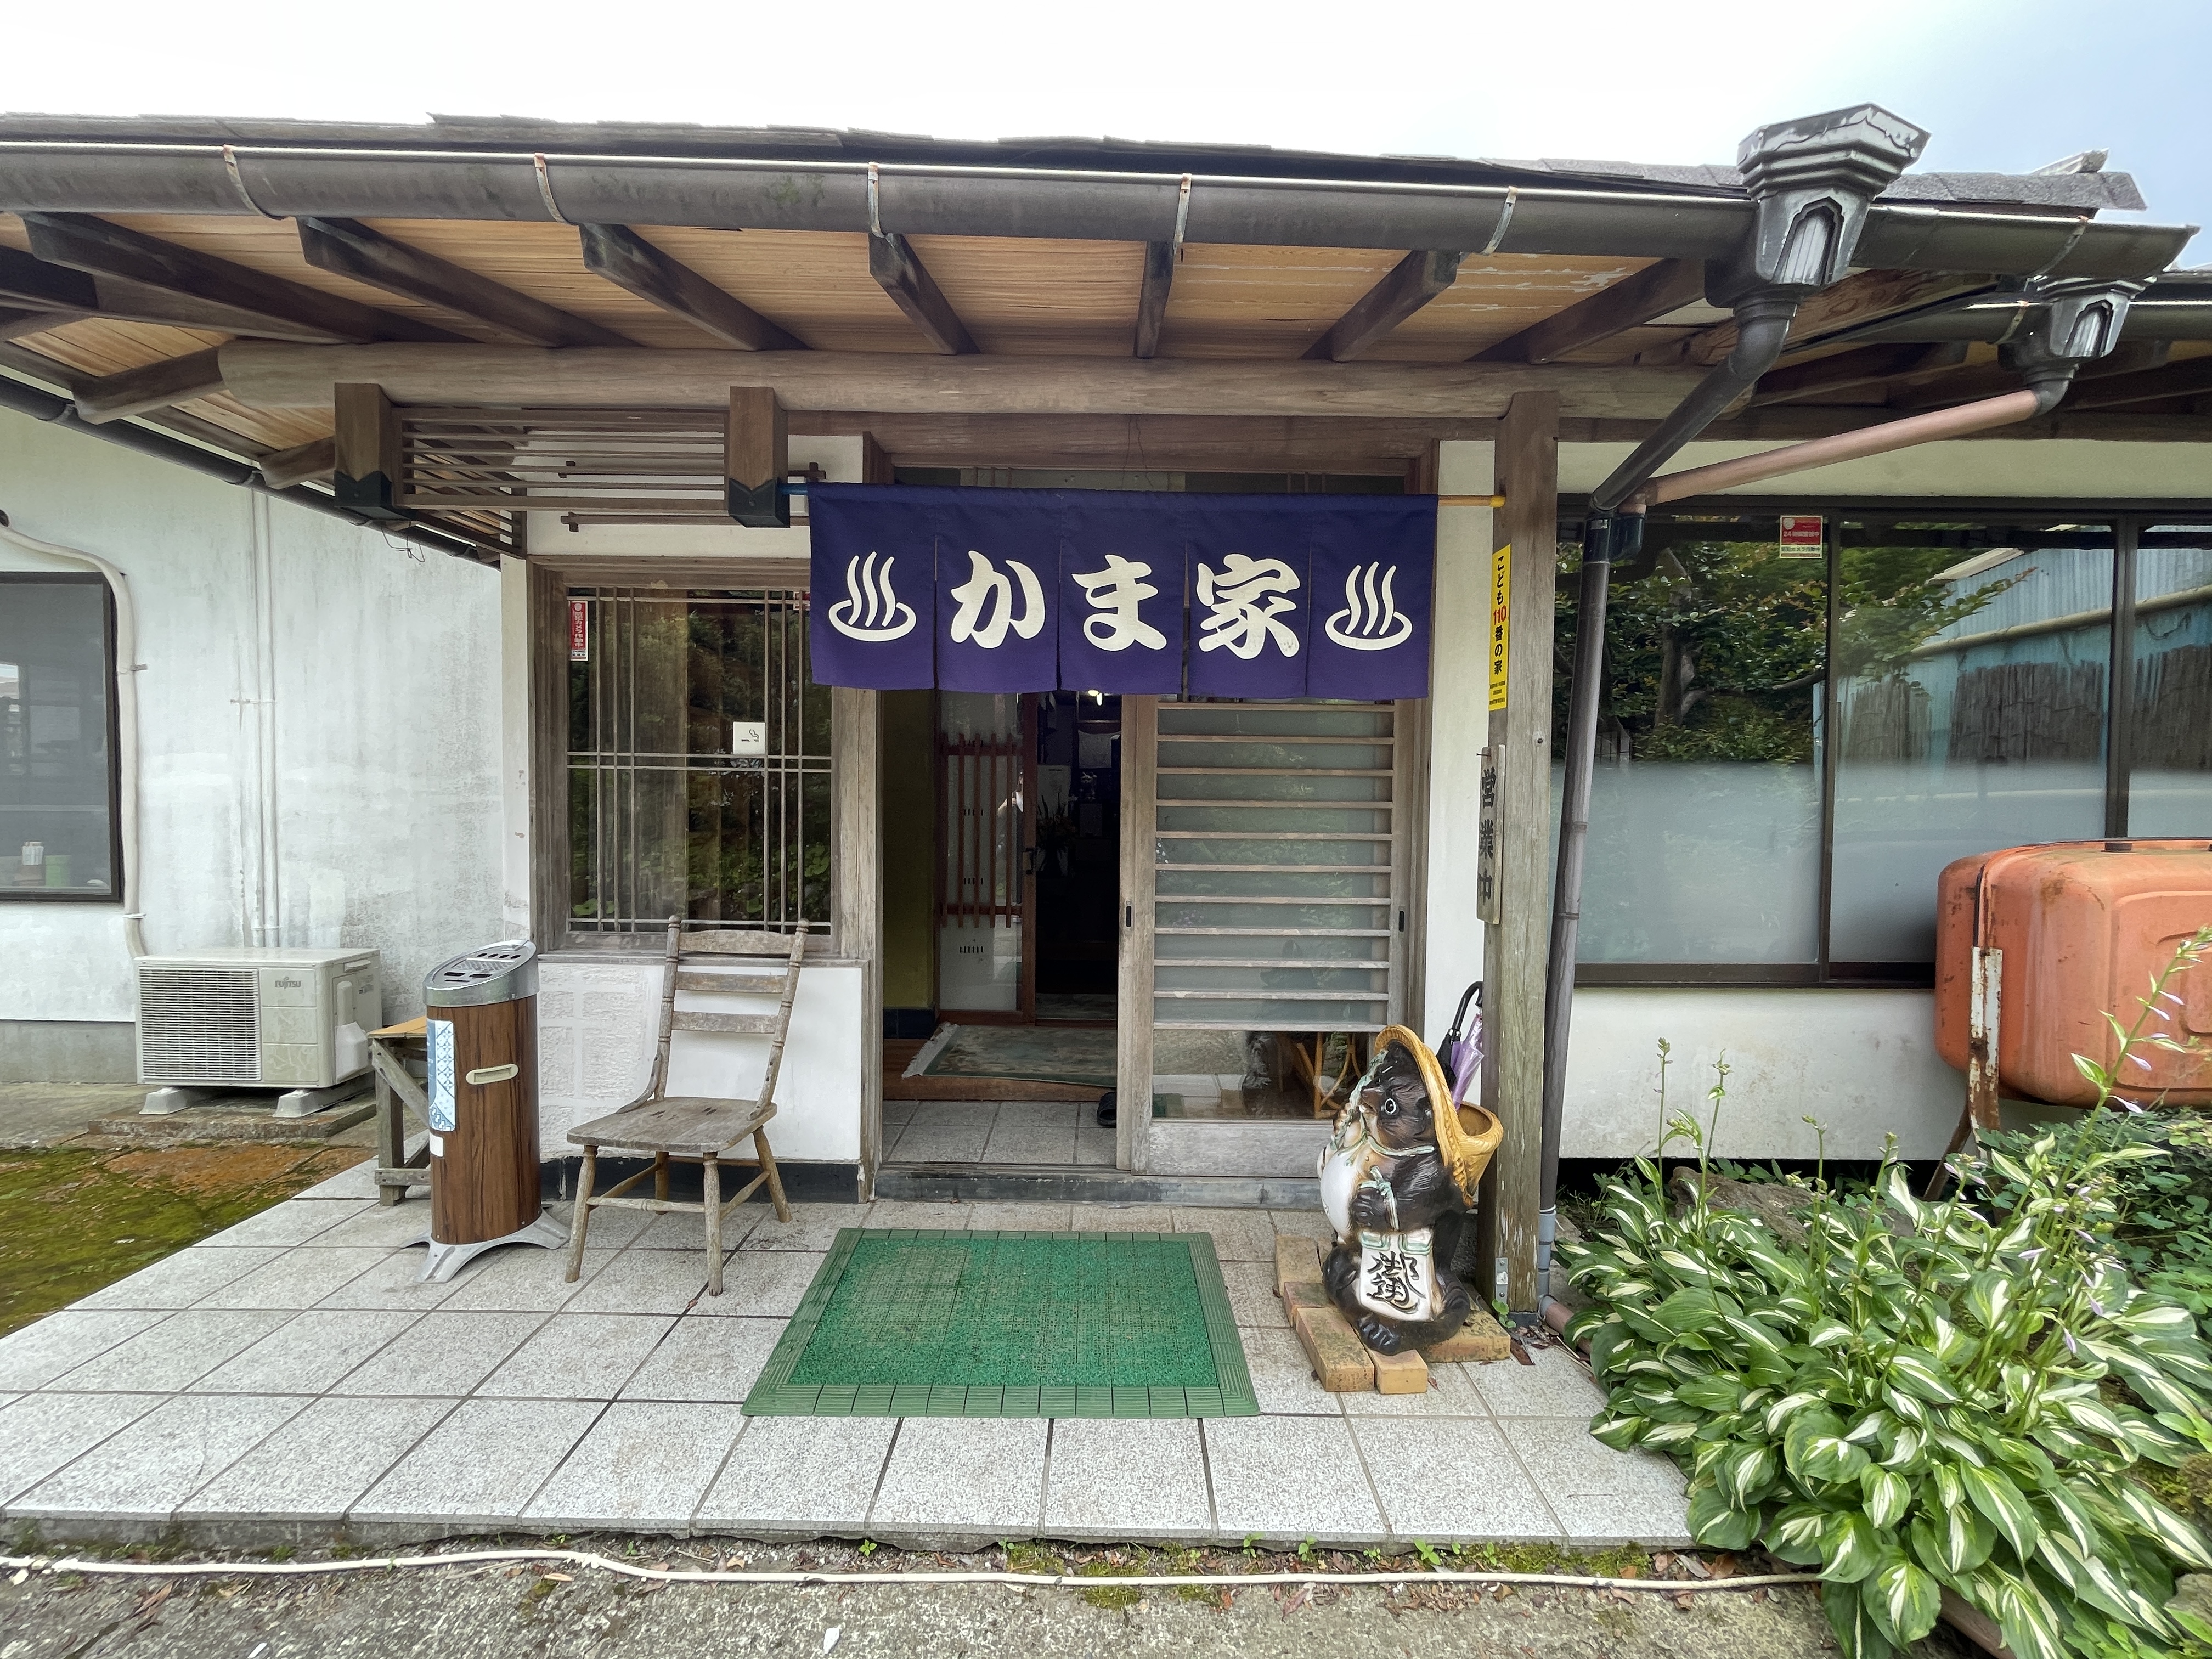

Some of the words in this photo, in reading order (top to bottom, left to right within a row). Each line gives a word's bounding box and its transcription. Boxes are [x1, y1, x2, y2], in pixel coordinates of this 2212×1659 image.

[950, 550, 1301, 659] かま家
[1493, 555, 1507, 675] こども110番の家
[1479, 766, 1497, 905] 営業中
[275, 977, 301, 989] FUJITSU
